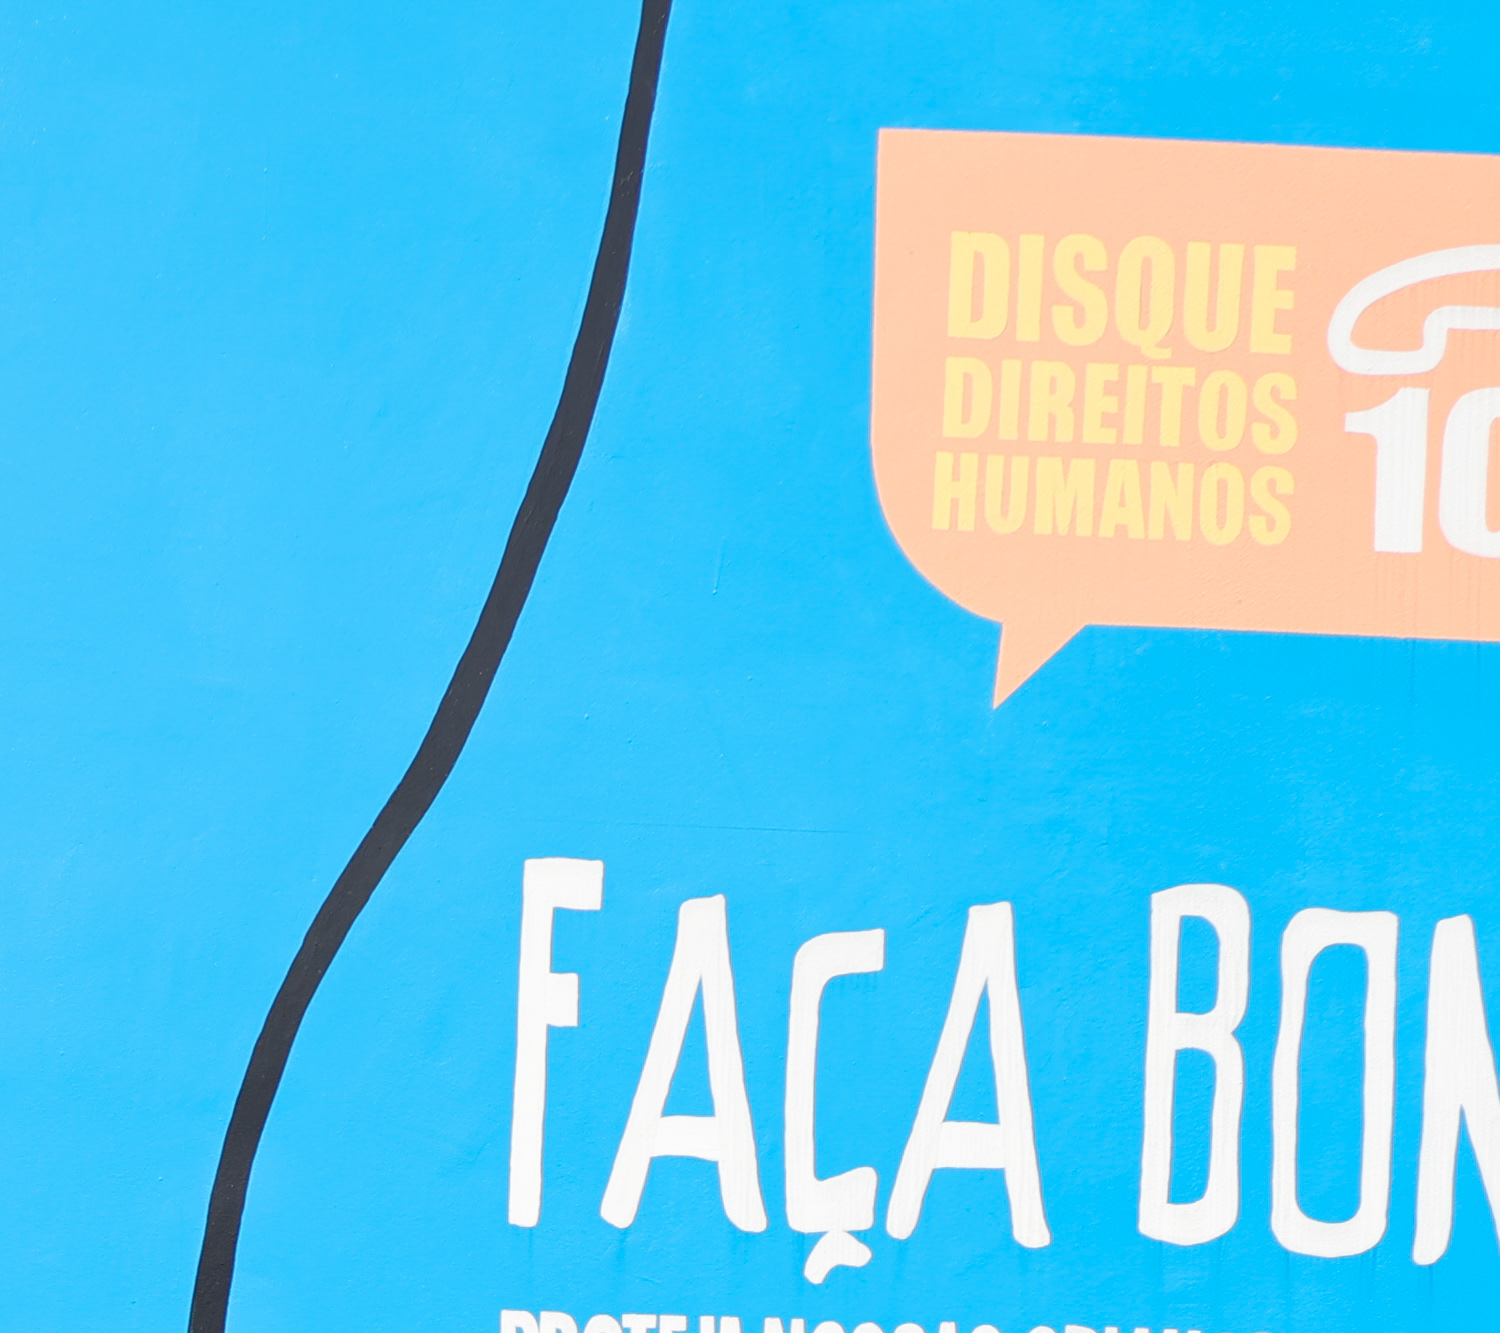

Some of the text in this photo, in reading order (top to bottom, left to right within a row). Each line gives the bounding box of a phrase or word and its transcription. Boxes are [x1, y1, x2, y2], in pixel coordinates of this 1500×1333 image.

[948, 230, 1298, 359] DISQUE
[943, 356, 1299, 454] DIREITOS
[932, 450, 1296, 545] HUMANOS
[508, 857, 1052, 1284] FAÇA
